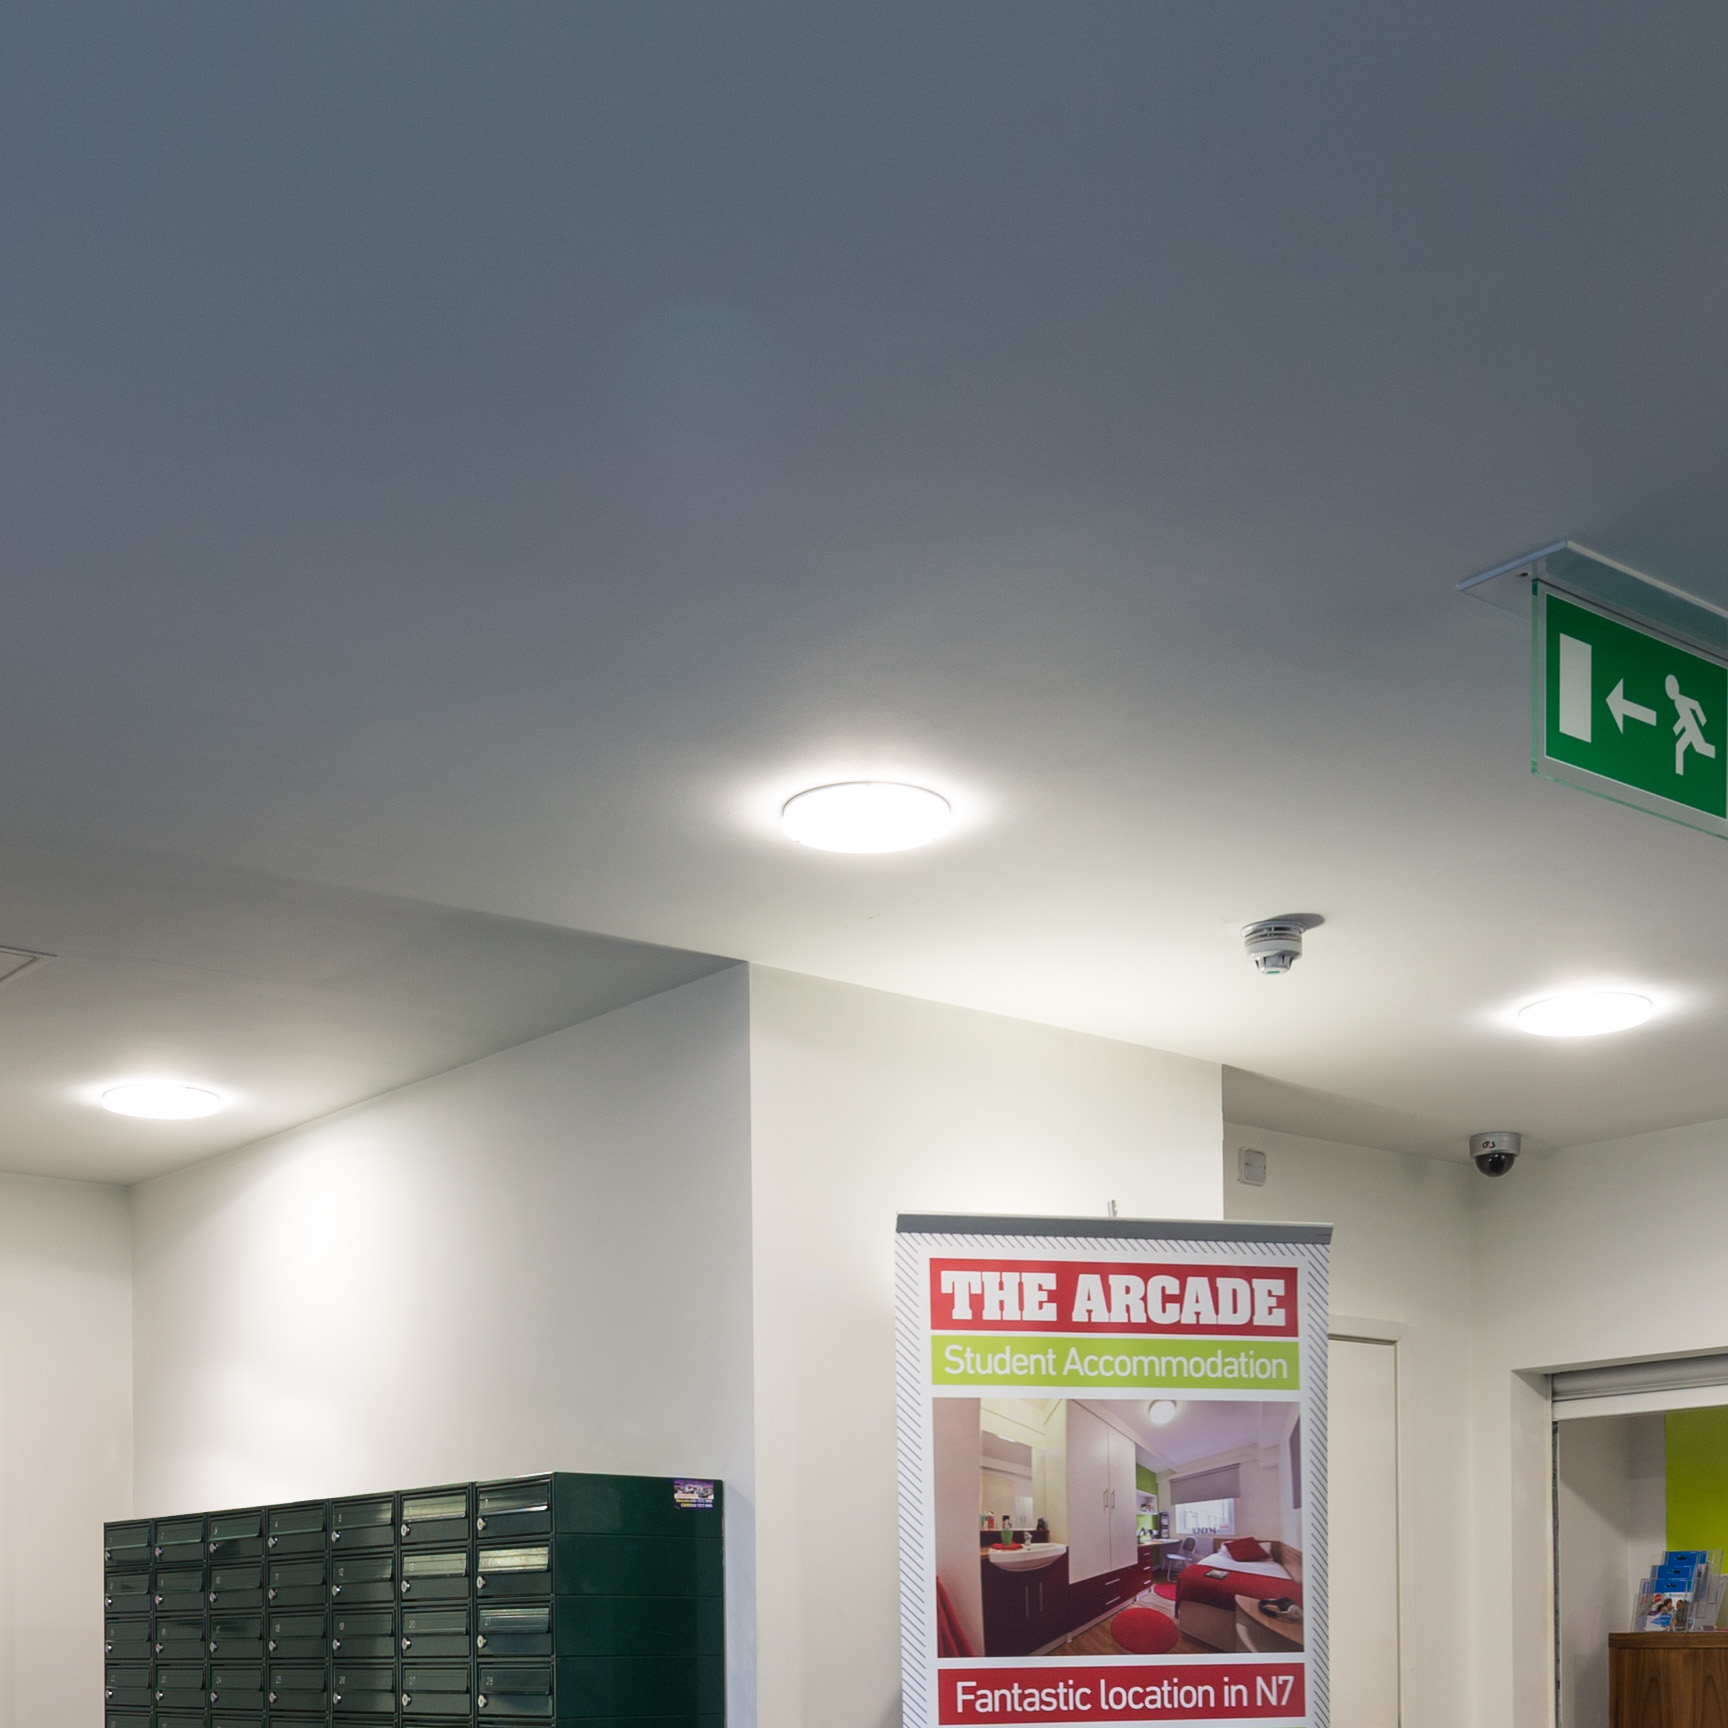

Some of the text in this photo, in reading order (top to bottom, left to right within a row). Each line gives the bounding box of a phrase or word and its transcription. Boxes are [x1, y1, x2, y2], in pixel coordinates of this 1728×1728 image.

[940, 1270, 1286, 1327] THE ARCADE
[944, 1344, 1288, 1379] Student Accommodation
[956, 1675, 1294, 1713] Fantastic location in N7
